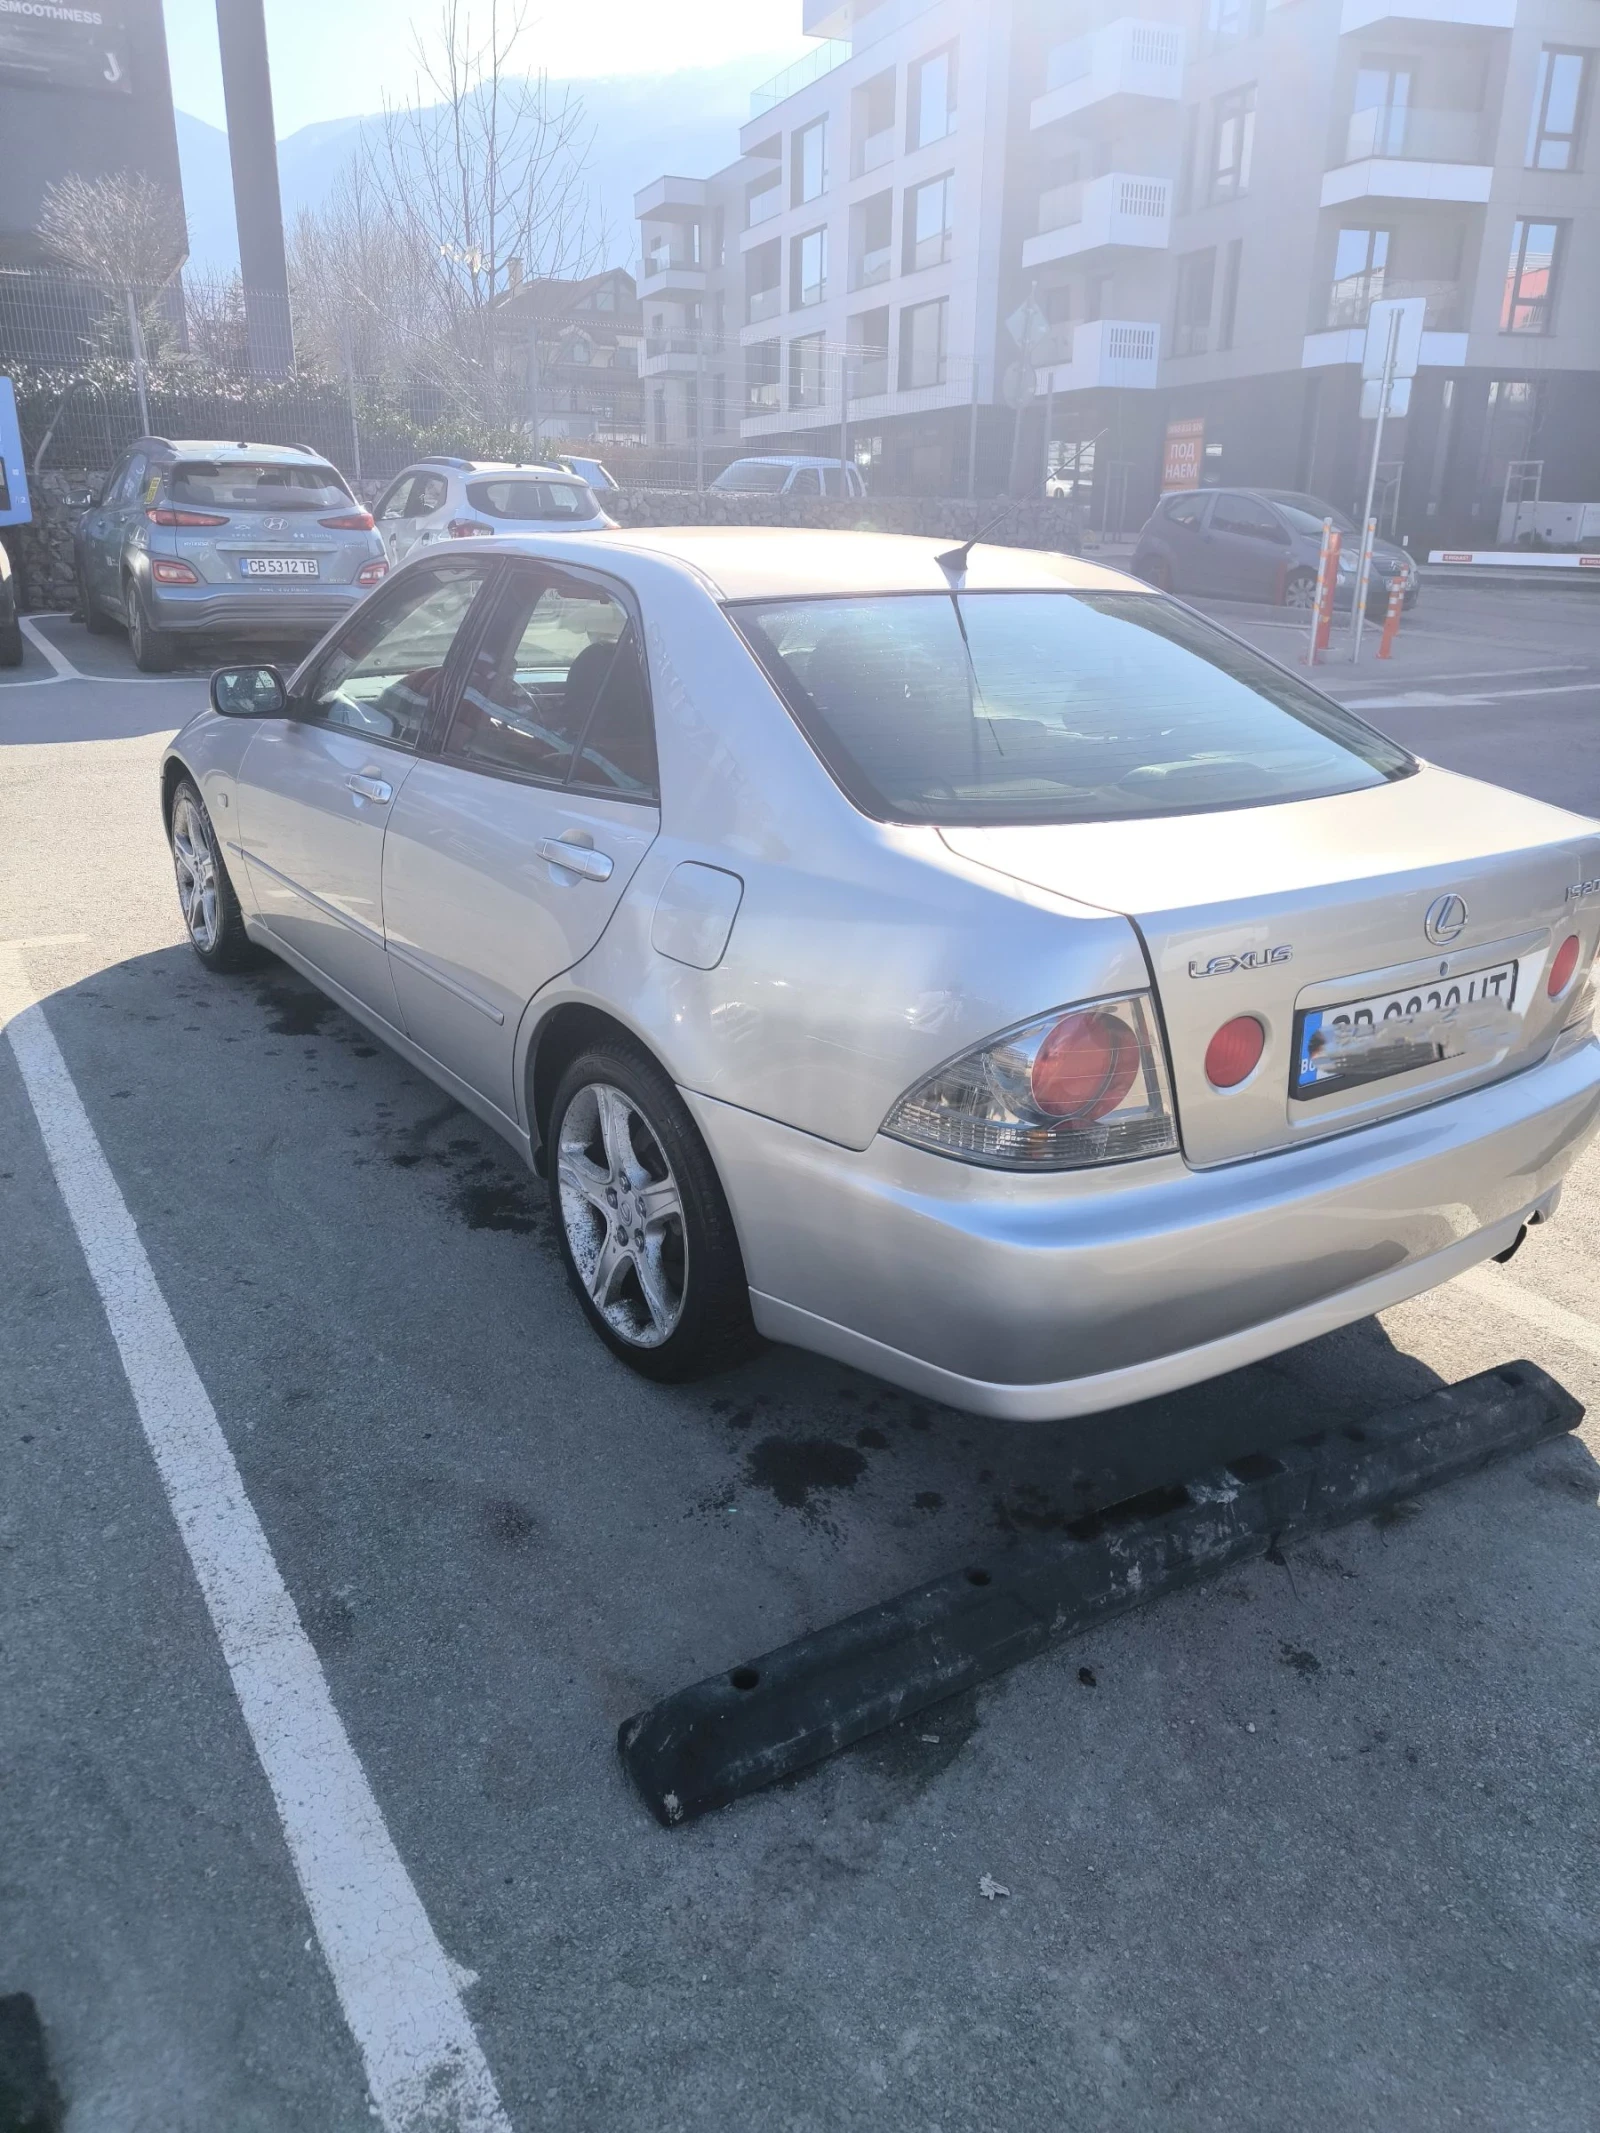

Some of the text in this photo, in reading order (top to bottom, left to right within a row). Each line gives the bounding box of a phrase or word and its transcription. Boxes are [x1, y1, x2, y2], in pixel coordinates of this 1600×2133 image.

[0, 0, 103, 25] SMOOTHNESS
[1170, 443, 1195, 461] ПОД
[1165, 463, 1198, 479] НАЕМ
[249, 560, 316, 573] CB 5312 TB
[1188, 945, 1293, 979] LEXUS
